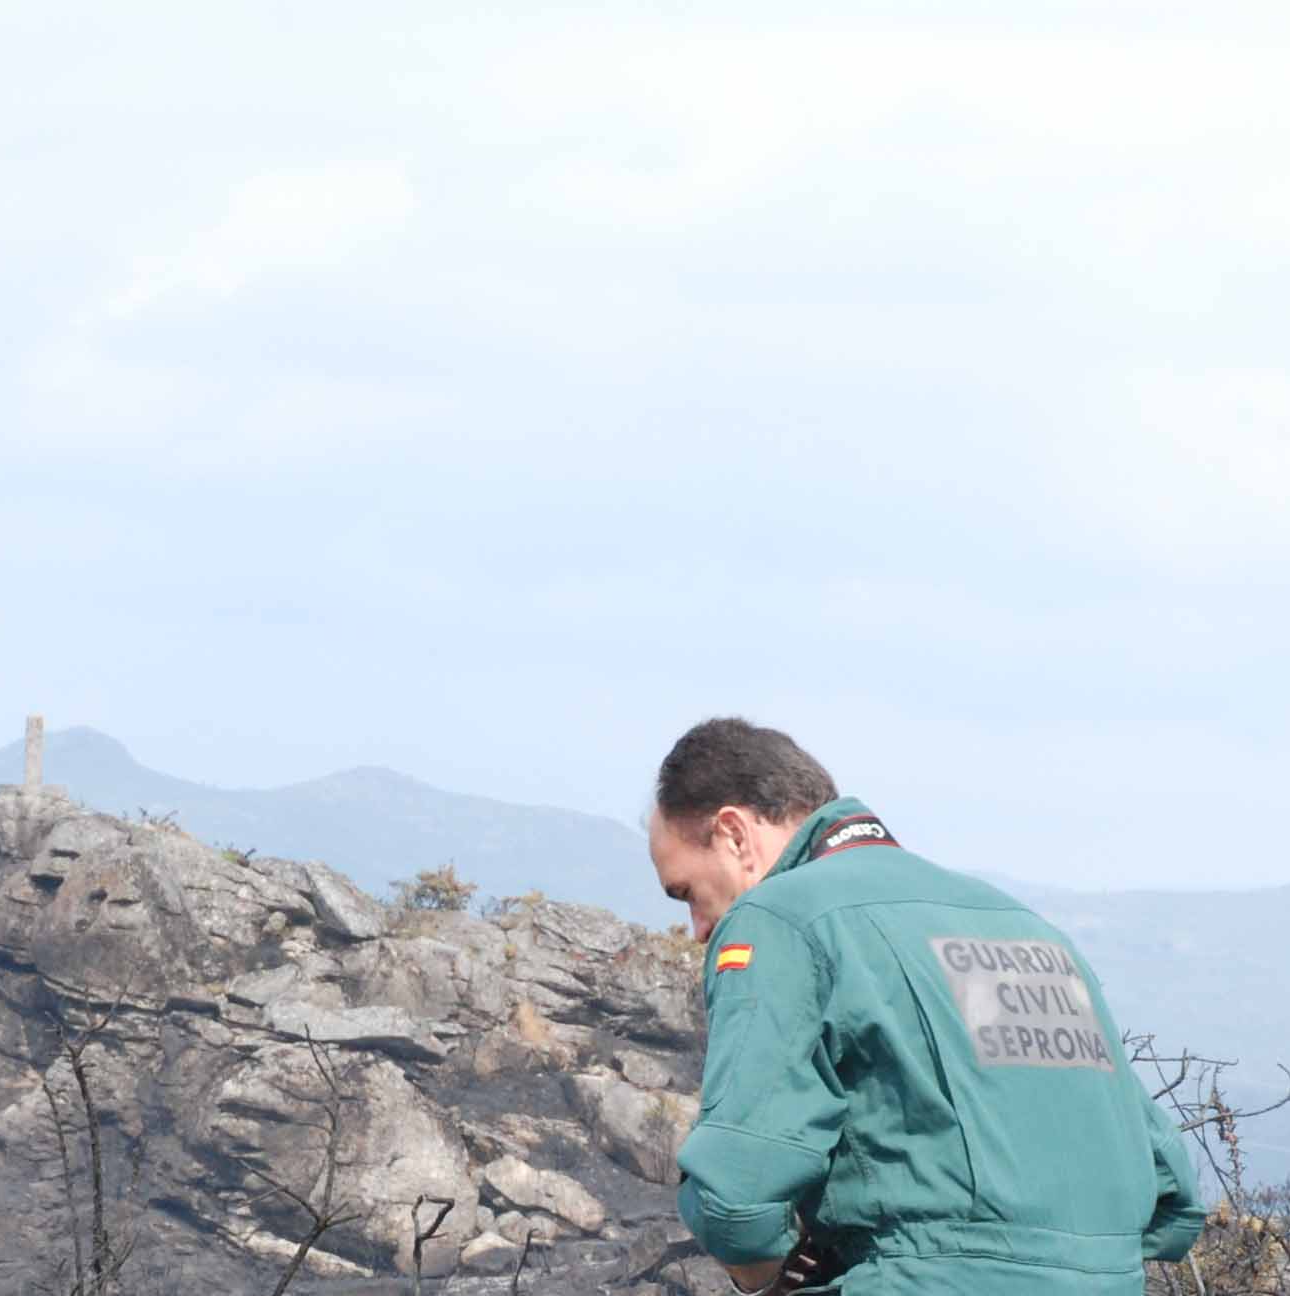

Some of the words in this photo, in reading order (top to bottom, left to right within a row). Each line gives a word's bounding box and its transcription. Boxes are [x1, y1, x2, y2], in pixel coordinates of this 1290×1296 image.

[942, 941, 1080, 978] GUARDIA
[997, 983, 1079, 1015] CIVIL
[979, 1026, 1111, 1064] SEPRONA
